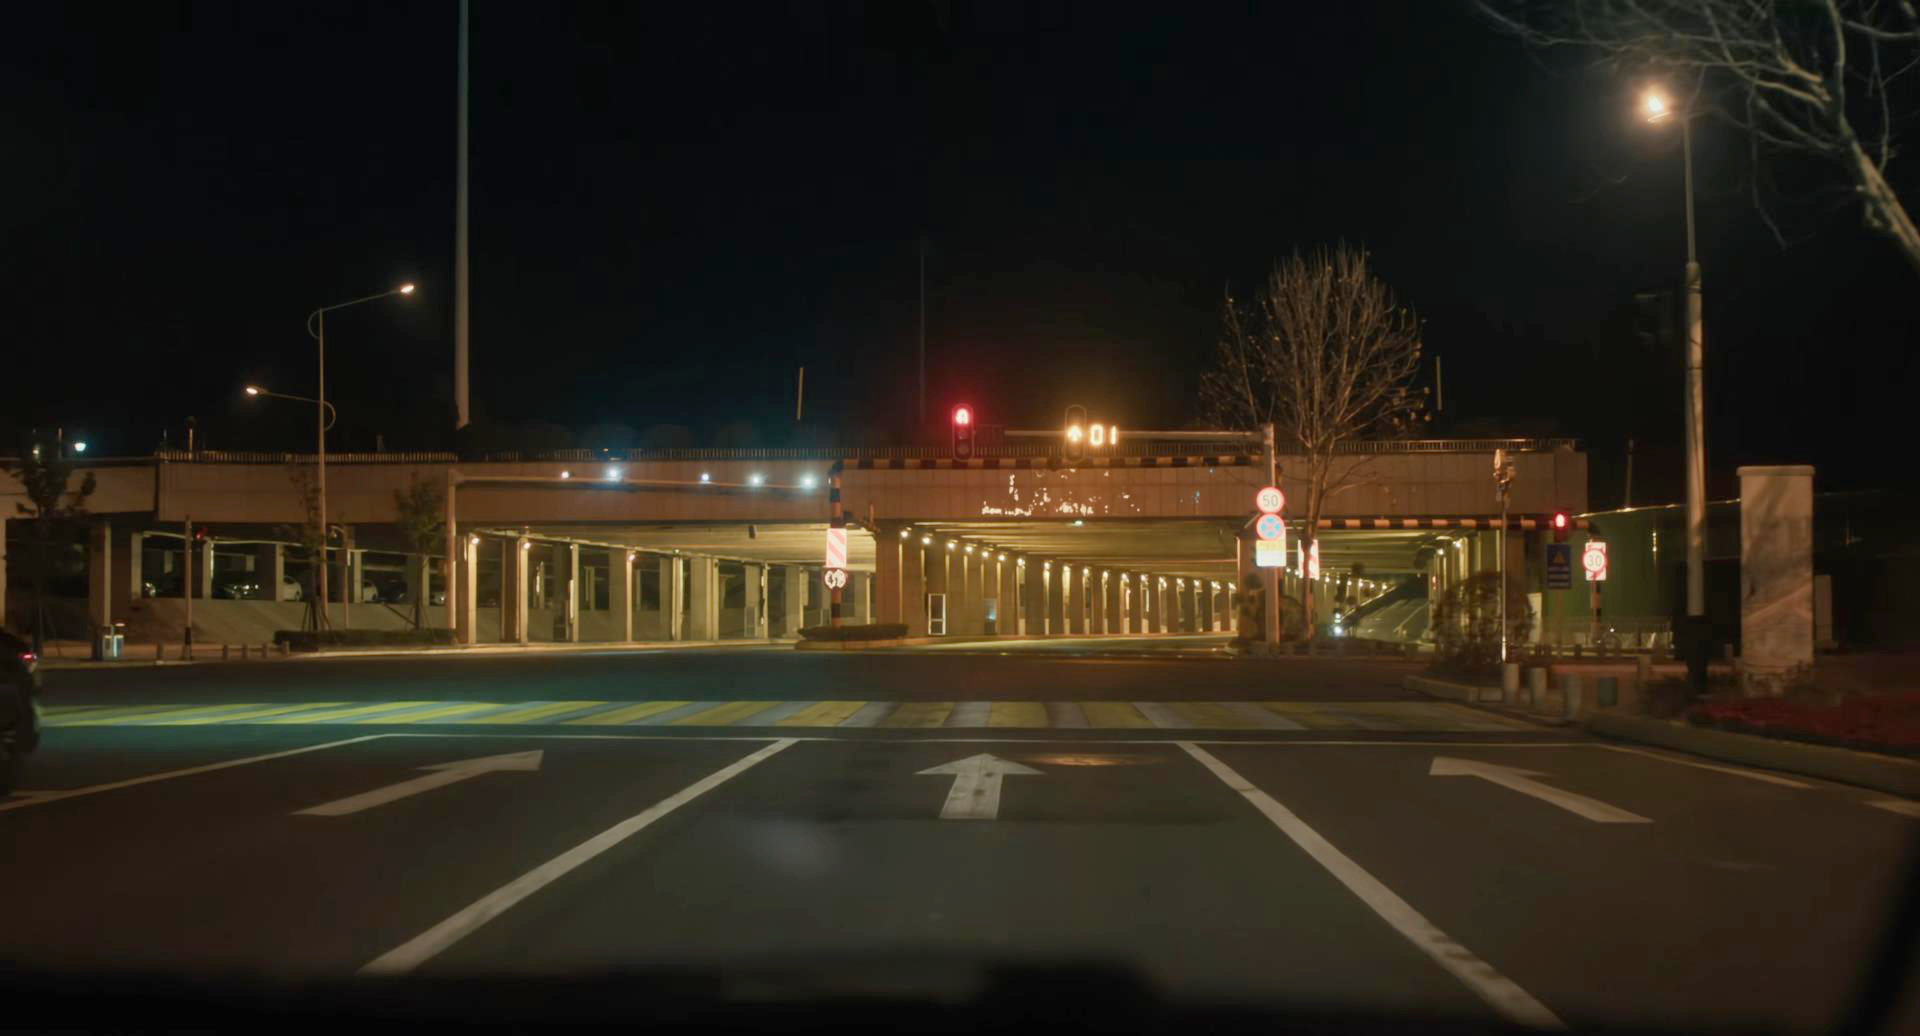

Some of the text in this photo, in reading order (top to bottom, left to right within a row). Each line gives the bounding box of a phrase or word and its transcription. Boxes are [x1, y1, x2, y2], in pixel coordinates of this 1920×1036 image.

[1090, 424, 1118, 446] 01
[1262, 494, 1279, 508] 50
[1587, 554, 1603, 568] 30
